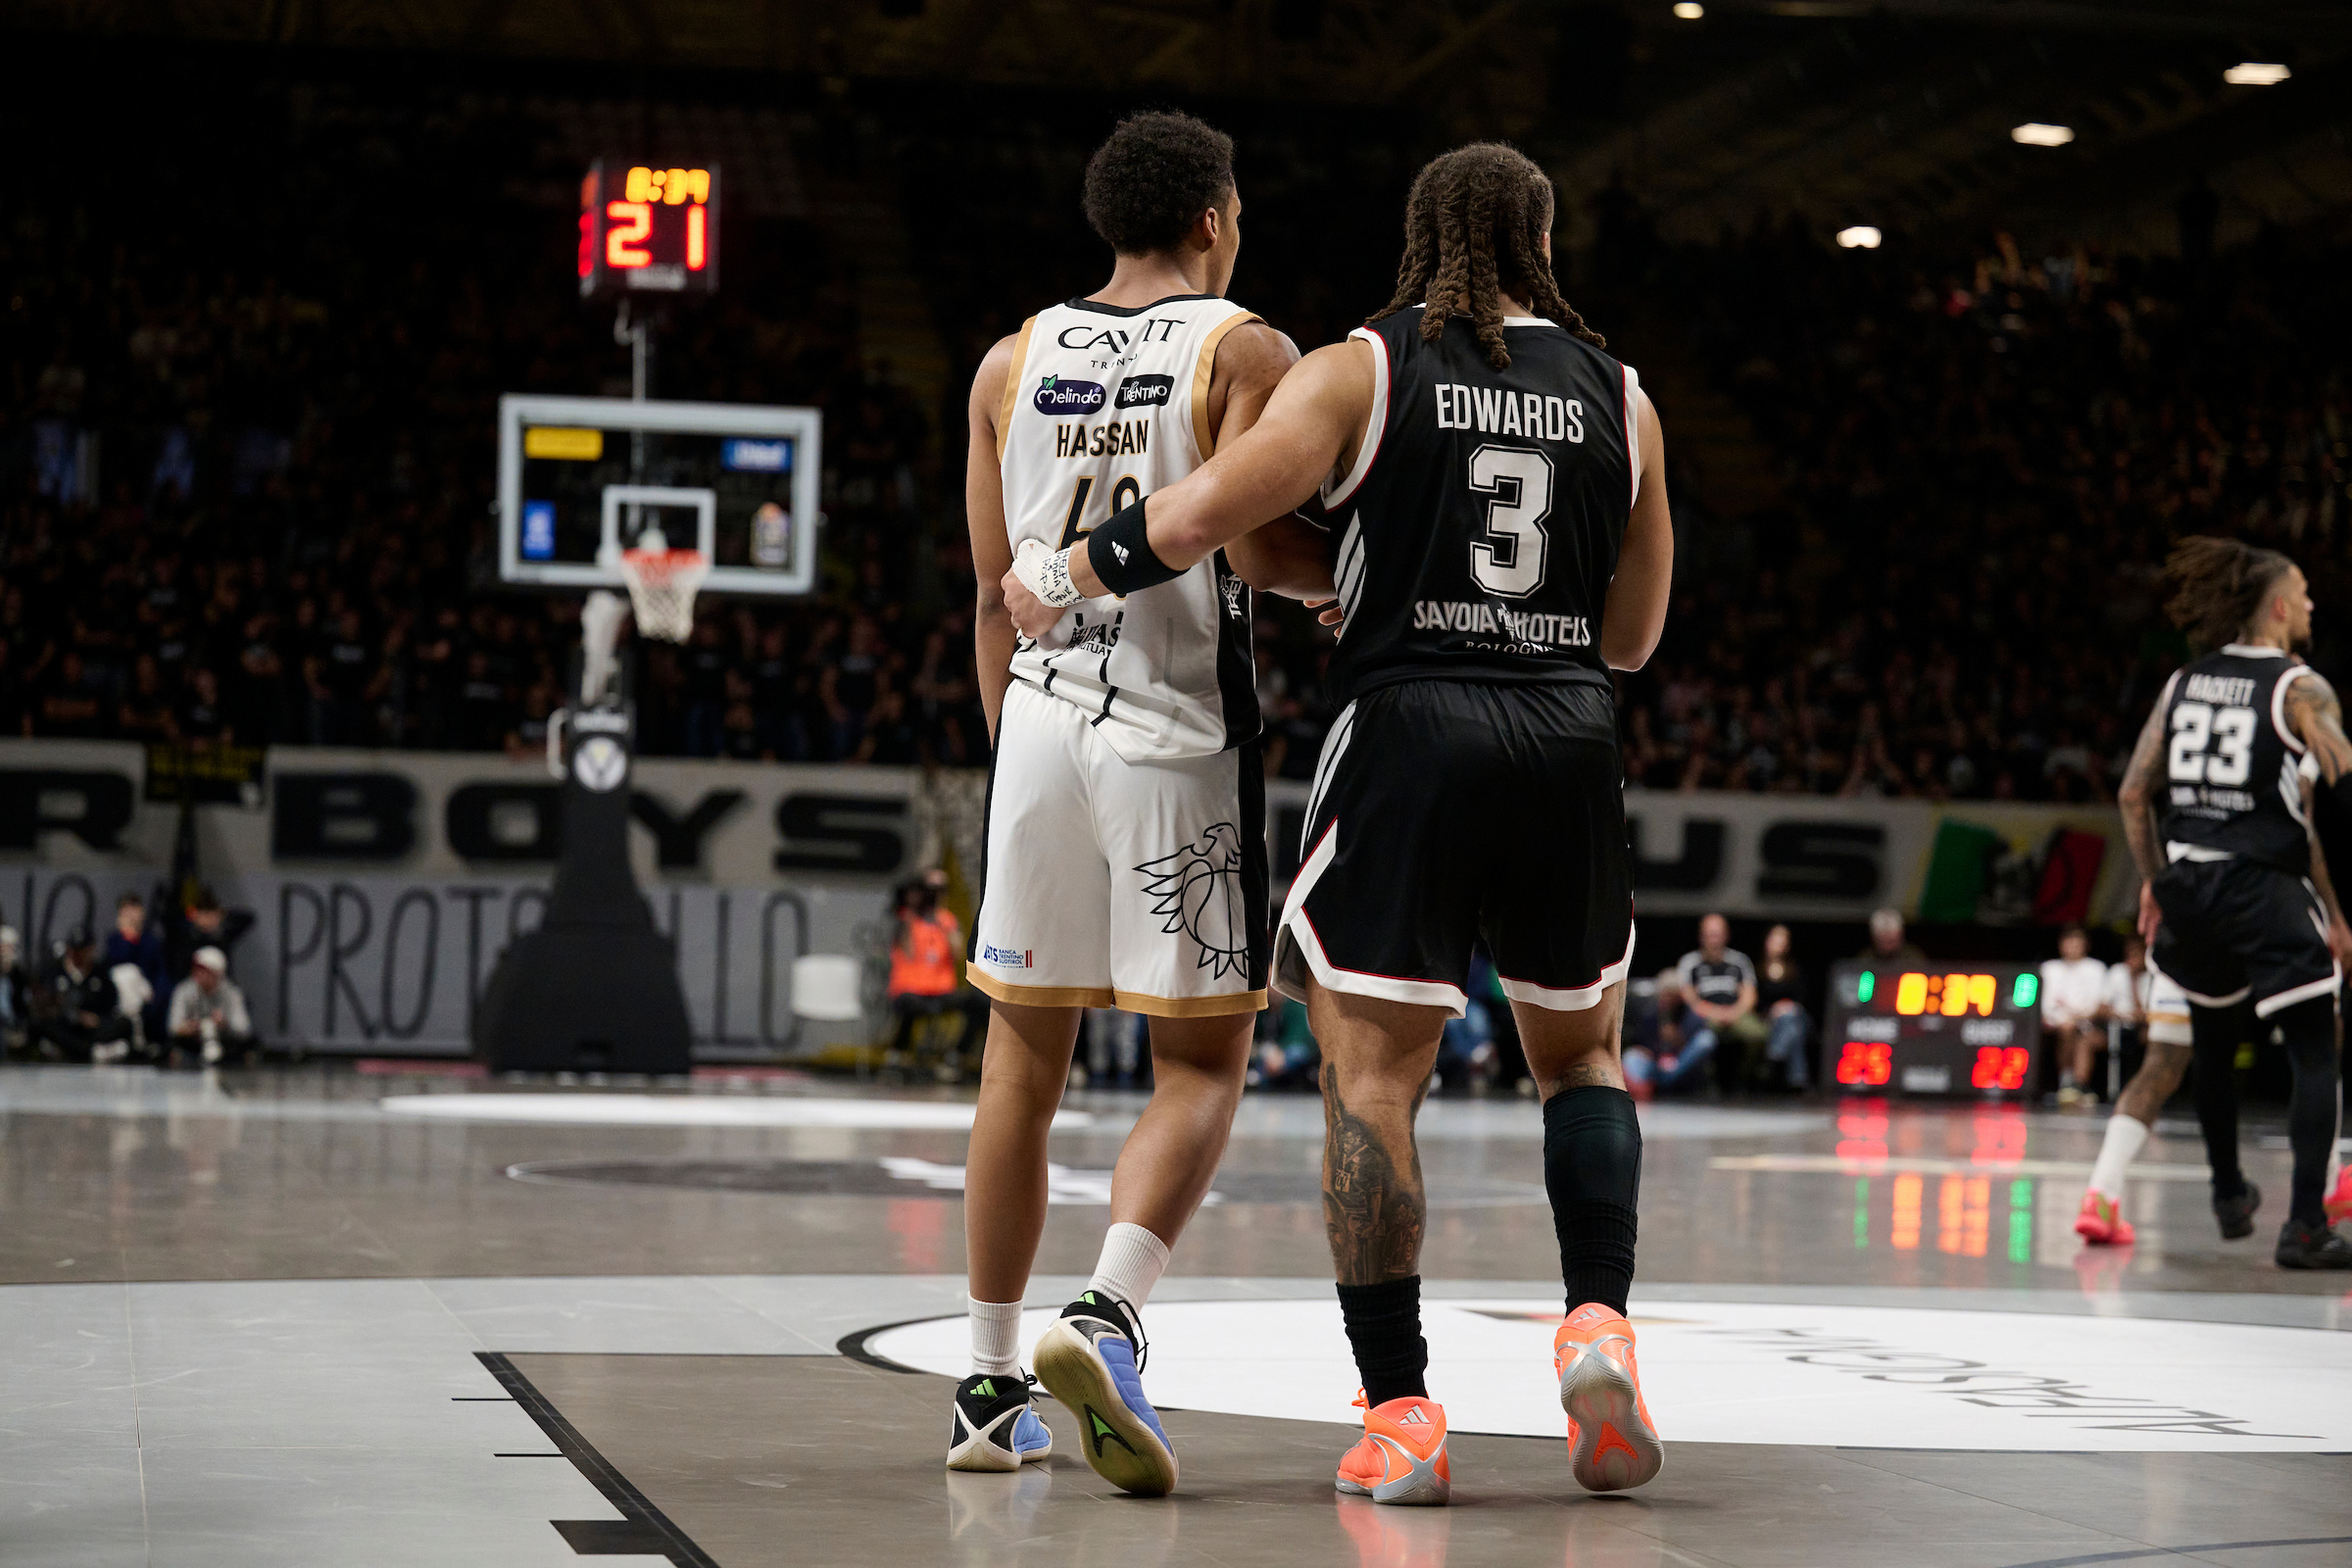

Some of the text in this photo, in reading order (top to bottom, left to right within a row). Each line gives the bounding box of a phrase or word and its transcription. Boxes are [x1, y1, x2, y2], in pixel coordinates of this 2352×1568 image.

[607, 200, 707, 271] 21
[1037, 386, 1102, 404] Melinda
[1435, 383, 1585, 444] EDWARDS
[1056, 418, 1150, 459] HASSAN
[1469, 443, 1555, 599] 3
[1413, 600, 1592, 647] SAVOIA HOTELS
[2168, 701, 2259, 788] 23
